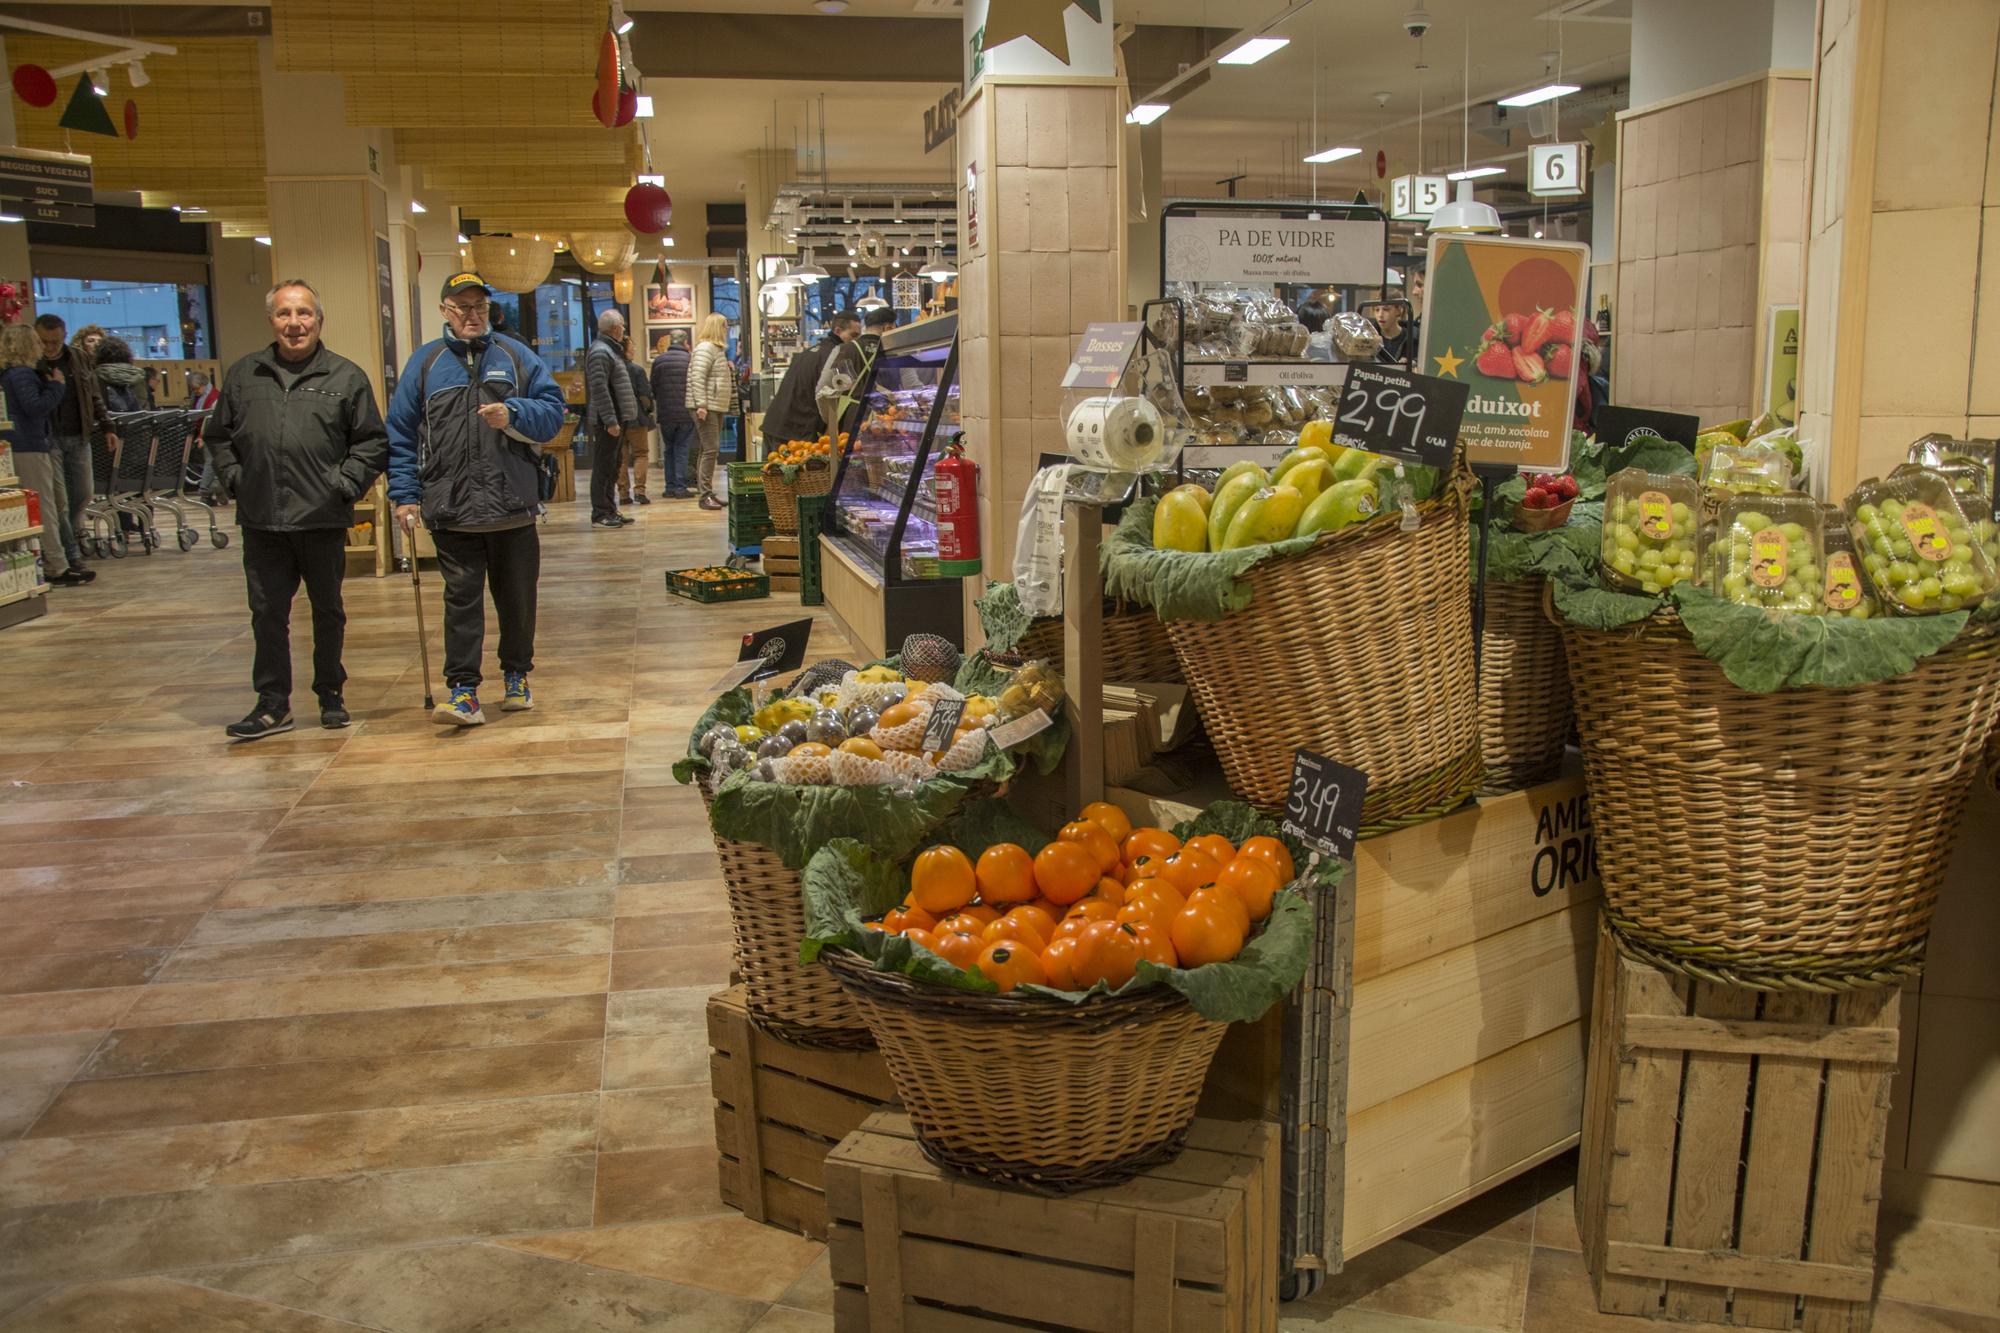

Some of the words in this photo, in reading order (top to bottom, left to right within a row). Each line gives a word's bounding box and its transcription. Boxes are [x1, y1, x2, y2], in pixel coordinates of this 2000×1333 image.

[44, 166, 89, 178] VEGETALS
[1545, 153, 1565, 181] 6
[1397, 185, 1407, 208] 5
[1423, 183, 1437, 206] 5
[37, 208, 60, 218] LLET
[1218, 229, 1242, 247] PA
[1247, 230, 1272, 248] DE
[1277, 231, 1336, 249] VIDRE
[1252, 253, 1275, 264] 100%
[1275, 254, 1302, 265] natural
[1086, 338, 1123, 353] Bosses
[1279, 370, 1291, 380] Oli
[1384, 375, 1411, 388] petita
[1463, 394, 1542, 418] duixot
[1340, 389, 1427, 447] 2,99
[1484, 424, 1507, 435] amb
[1508, 427, 1550, 438] xocolata
[1480, 437, 1494, 447] de
[1288, 777, 1341, 833] 3,49
